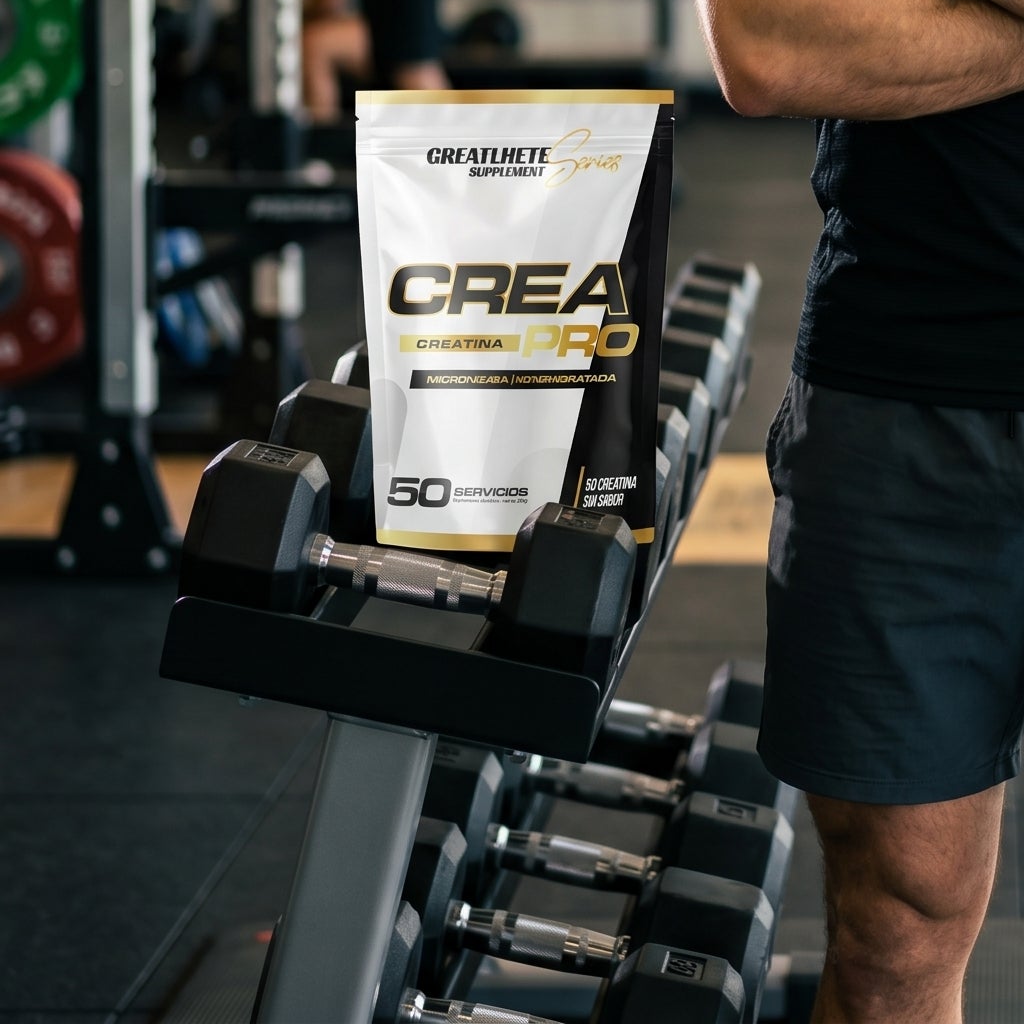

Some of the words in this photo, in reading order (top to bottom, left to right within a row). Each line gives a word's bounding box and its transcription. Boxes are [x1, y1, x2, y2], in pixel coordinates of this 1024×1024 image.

[426, 146, 552, 165] GREATLHETE
[468, 166, 546, 178] SUPPLEMENT
[387, 262, 630, 317] CREA
[416, 338, 504, 350] CREATINA
[521, 323, 640, 359] PRO
[387, 476, 452, 508] 50
[453, 487, 529, 497] SERVICIOS
[585, 477, 598, 492] 50
[597, 475, 638, 491] CREATINA
